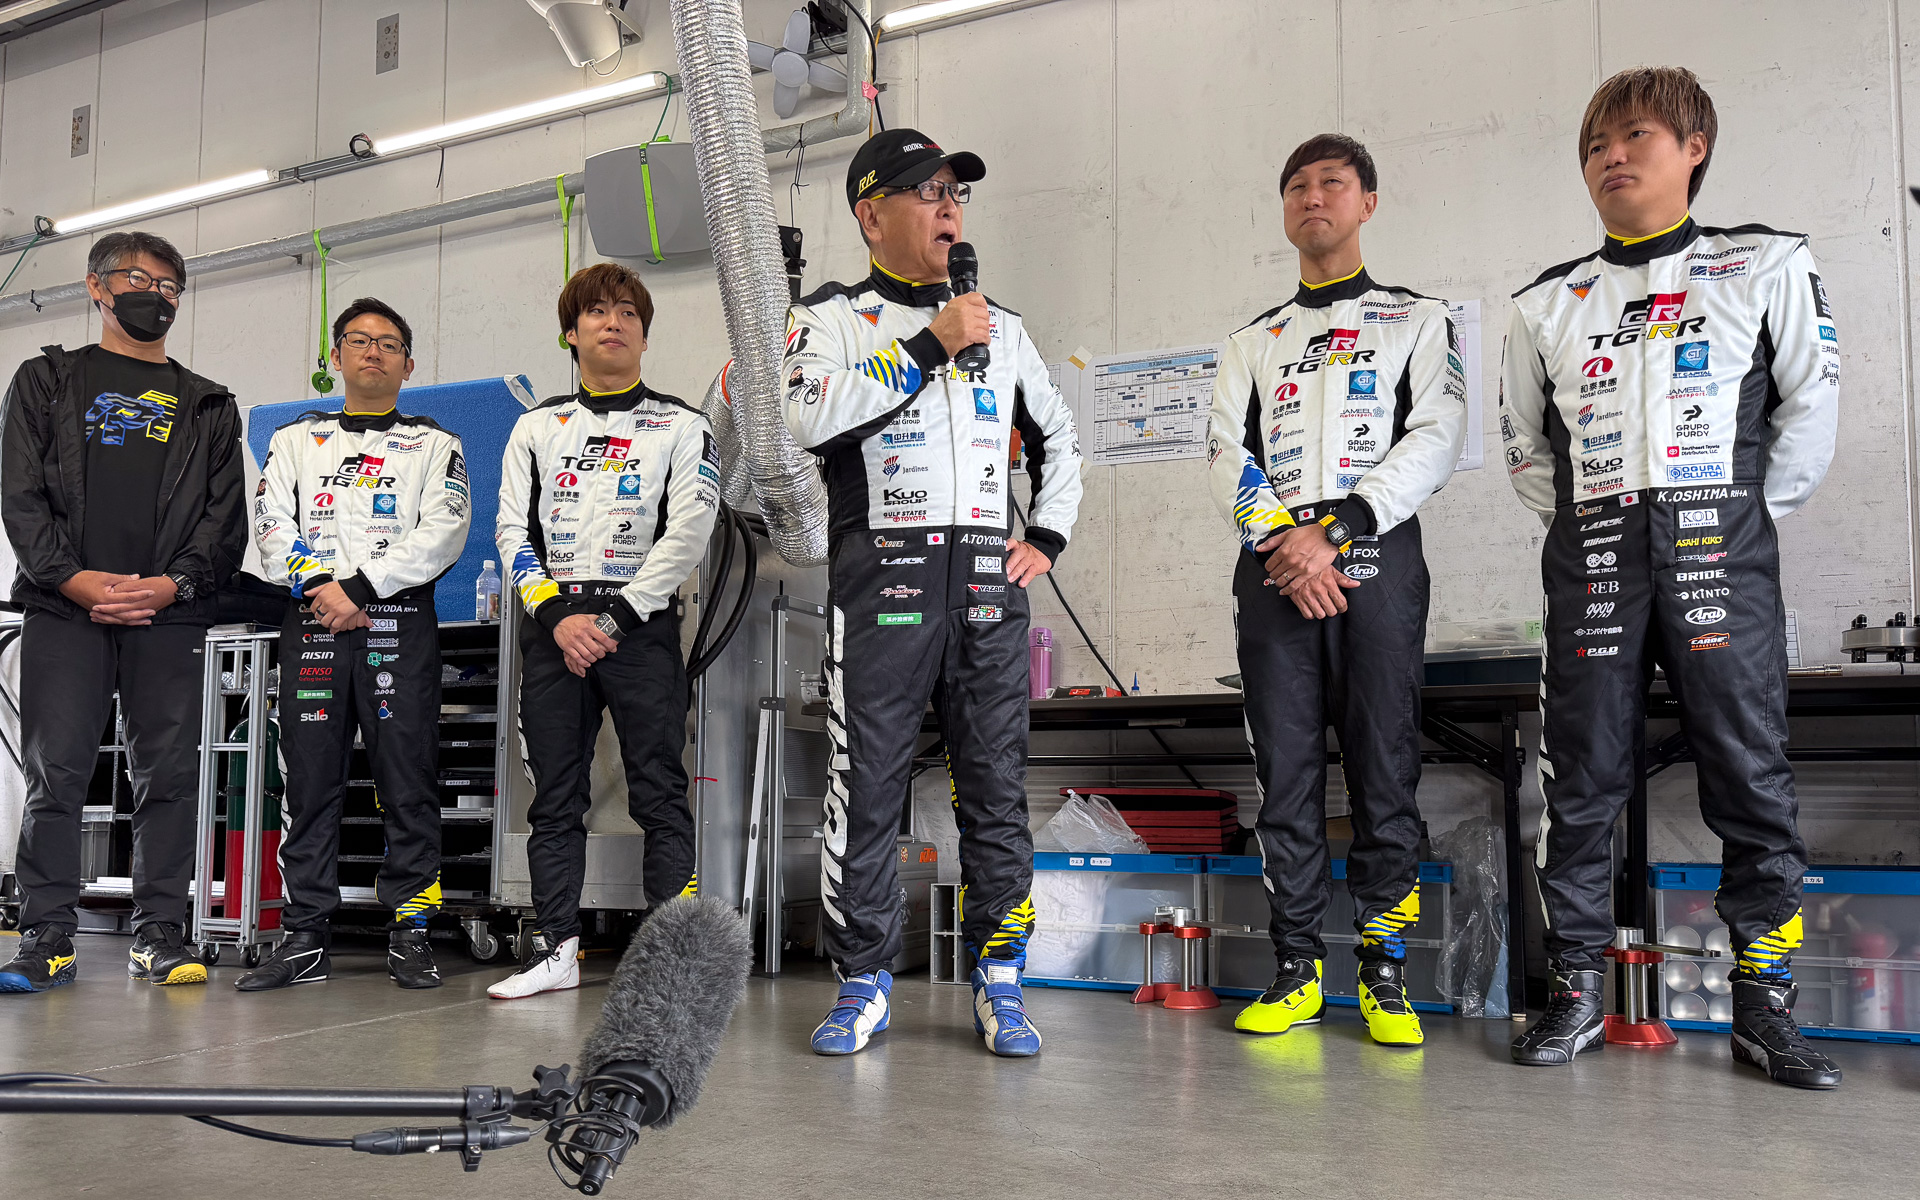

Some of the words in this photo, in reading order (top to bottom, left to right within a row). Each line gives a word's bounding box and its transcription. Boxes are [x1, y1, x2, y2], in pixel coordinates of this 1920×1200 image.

[1684, 245, 1758, 262] BRIDGESTONE
[1708, 260, 1748, 271] Super
[1709, 266, 1745, 276] Taikyu
[1360, 300, 1418, 309] BRIDGESTONE
[1580, 391, 1596, 400] Hotal
[1597, 386, 1617, 395] Group
[1666, 386, 1705, 395] JAMEEL
[1285, 408, 1300, 416] Group
[1596, 410, 1623, 422] Jardines
[1283, 429, 1304, 439] Jardines
[903, 466, 928, 474] Jardines
[1583, 465, 1623, 478] GROUP
[1583, 482, 1597, 490] GULF
[1598, 477, 1623, 487] STATES
[1598, 483, 1624, 492] TOYOTA
[1657, 488, 1728, 502] K.OSHIMA
[1731, 489, 1748, 498] RH+A
[1682, 510, 1714, 523] KOD
[960, 533, 1003, 546] A.TOYODA
[1676, 537, 1699, 547] ASAHI
[1702, 535, 1723, 545] KIKO
[1353, 548, 1380, 558] FOX
[977, 557, 1000, 568] KOD
[1587, 581, 1620, 595] REB
[301, 651, 334, 660] AISIN
[300, 667, 332, 676] DENSO
[300, 711, 328, 721] Stilo
